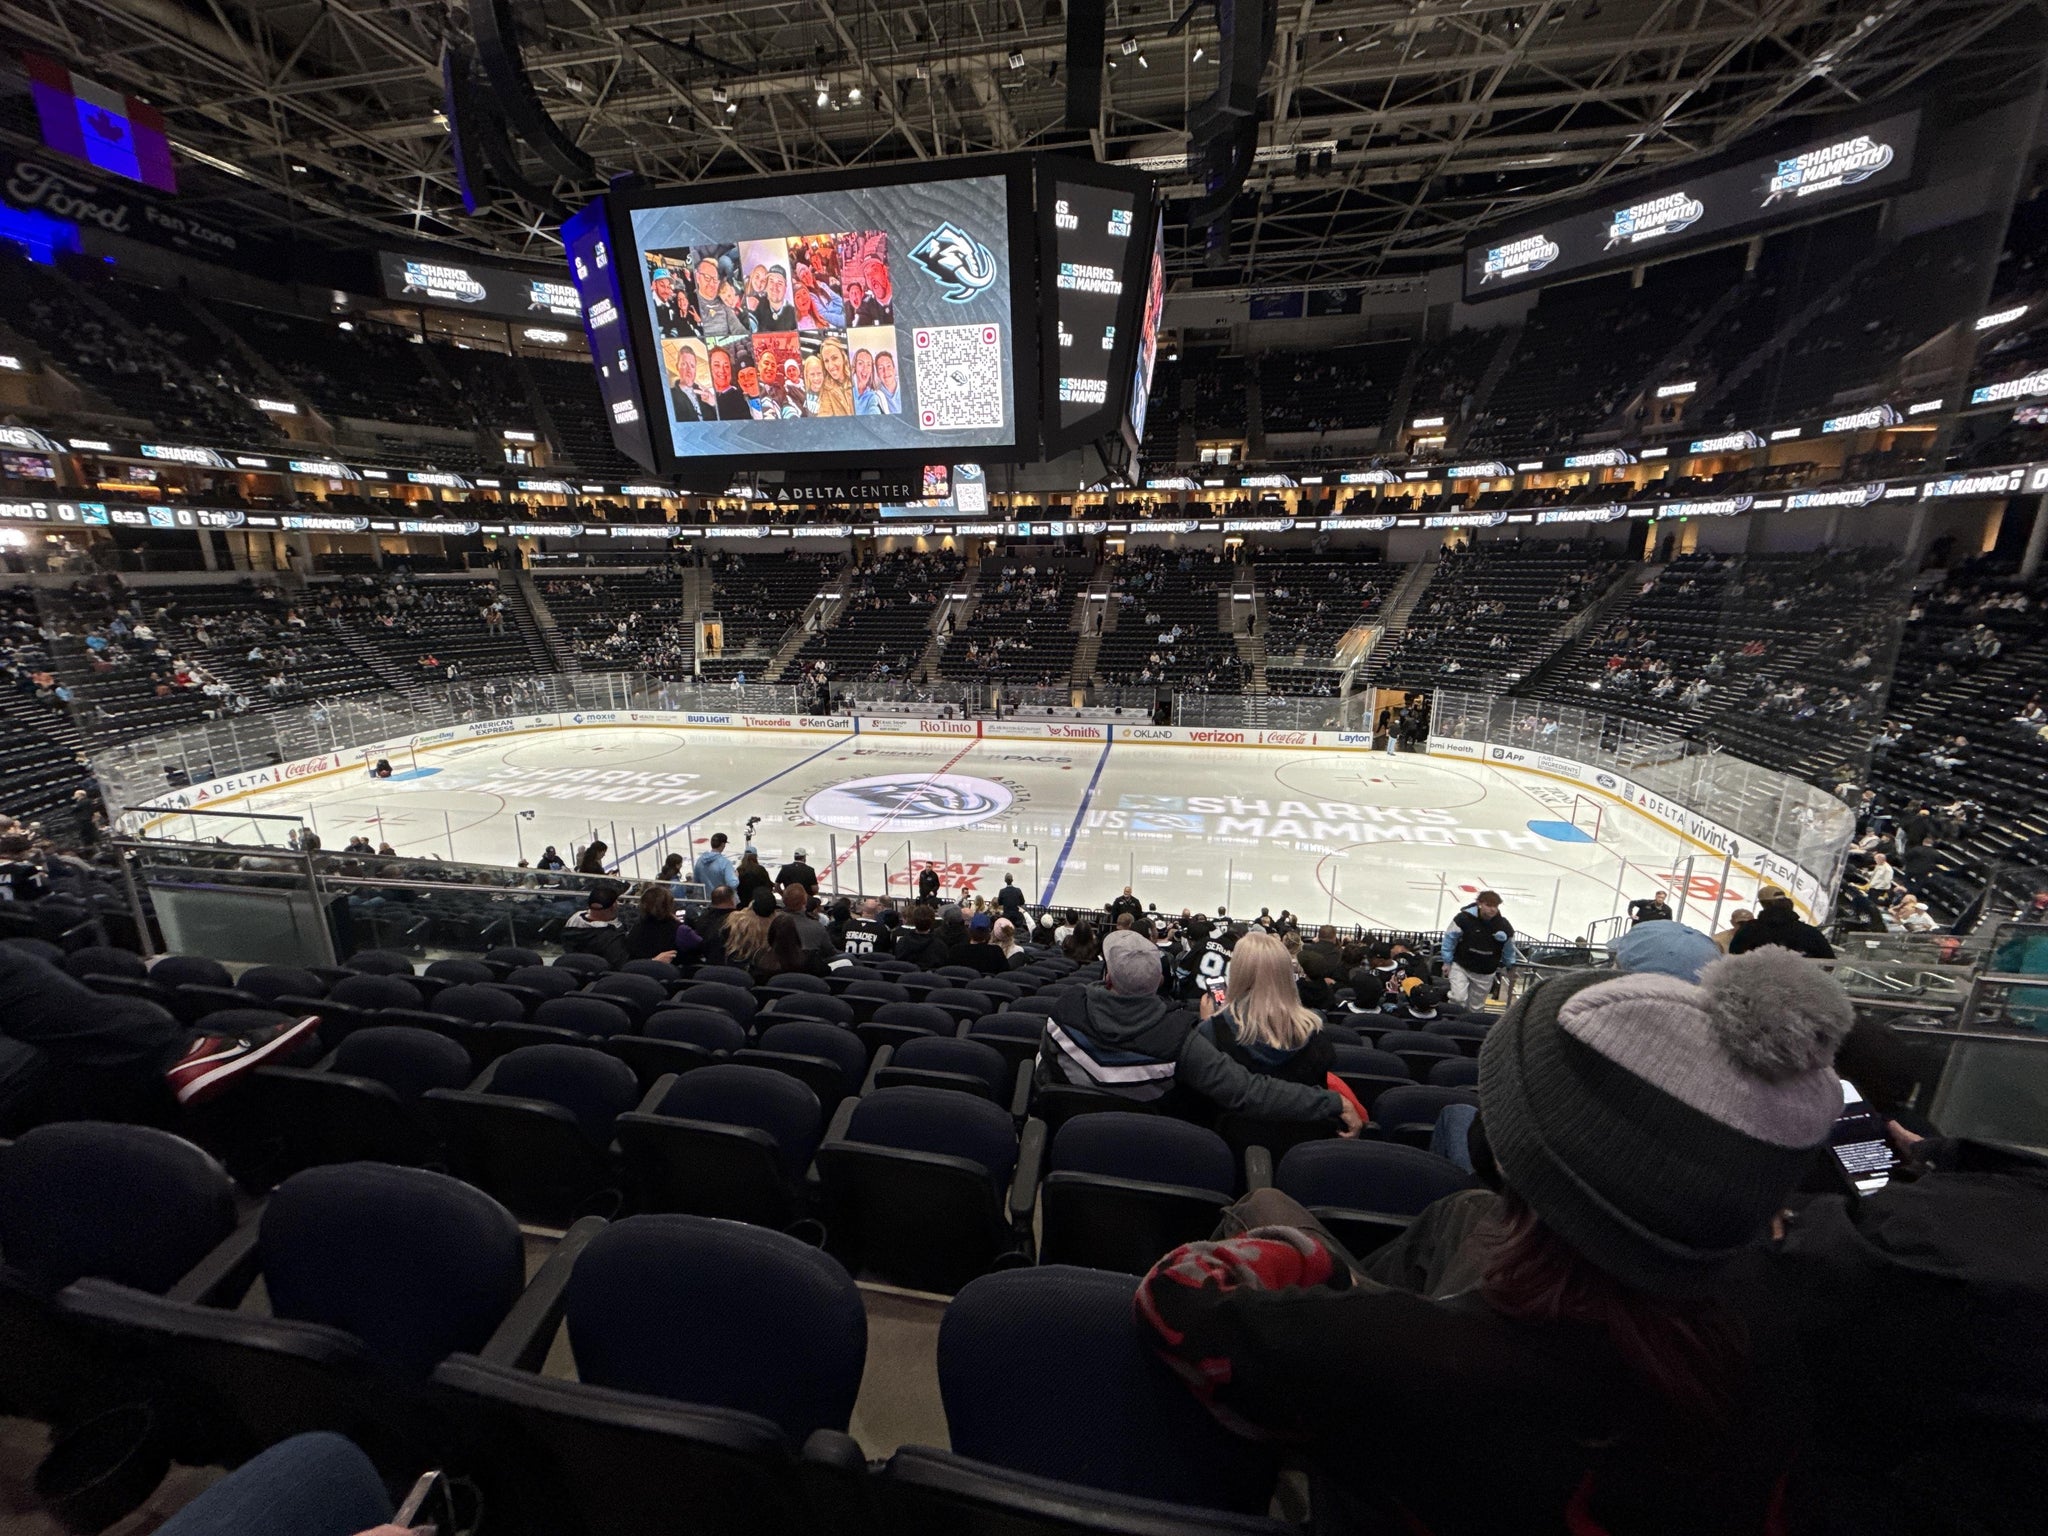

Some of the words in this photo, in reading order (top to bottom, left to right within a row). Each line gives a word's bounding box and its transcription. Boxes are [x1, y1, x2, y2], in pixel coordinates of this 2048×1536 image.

[1796, 135, 1869, 169] SHARKS
[1801, 144, 1885, 183] MAMMOTH
[6, 162, 129, 233] Ford
[145, 205, 186, 234] Fan
[190, 222, 236, 250] Zone
[1629, 192, 1685, 220] SHARKS
[1634, 201, 1697, 231] MAMMOTH
[1501, 234, 1544, 257] SHARKS
[1503, 242, 1554, 267] MAMMOTH
[420, 263, 467, 281] SHARKS
[1072, 264, 1114, 281] SHARKS
[427, 277, 480, 294] MAMMOTH
[543, 283, 580, 298] SHARK
[1076, 277, 1123, 295] MAMMOTH
[550, 295, 582, 308] MAMM
[1067, 378, 1108, 393] SHARKS
[1988, 372, 2048, 401] SHARKS
[1071, 390, 1106, 404] MAMMO
[1834, 410, 1882, 430] SHARKS
[1703, 434, 1744, 451] SHARKS
[156, 446, 208, 463] SHARKS
[1576, 453, 1615, 467] SHARKS
[300, 461, 340, 475] SHARKS
[1458, 465, 1494, 477] SHARKS
[418, 473, 453, 485] SHARKS
[1155, 478, 1185, 489] SHARKS
[1250, 477, 1281, 487] SHARKS
[1349, 472, 1384, 483] SHARKS
[528, 480, 562, 492] SHARKS
[630, 486, 661, 496] SHARKS
[793, 487, 844, 499] DELTA
[850, 485, 910, 497] CENTER
[1950, 475, 2009, 495] MAMMO
[1807, 490, 1867, 507] MAMMOTH
[57, 504, 75, 521] 0
[111, 511, 146, 523] 8:53
[177, 510, 192, 525] 0
[1558, 508, 1610, 522] MAMMOTH
[1680, 502, 1734, 515] MAMMOTH
[302, 518, 355, 530] MAMMOTH
[418, 522, 466, 534] MAMMOTH
[1150, 522, 1187, 532] MAMMOTH
[1240, 520, 1281, 531] MAMMOTH
[1337, 519, 1383, 530] MAMMOTH
[1442, 516, 1492, 527] MAMMOTH
[527, 526, 571, 536] MAMMOTH
[627, 527, 669, 537] MAMMOTH
[721, 527, 759, 537] MAMMOTH
[804, 527, 842, 537] MAMMOTH
[970, 526, 998, 536] MAMMO
[469, 719, 513, 731] AMERICAN
[688, 715, 705, 723] BUD
[706, 716, 730, 724] LIGHT
[750, 717, 792, 727] Trucordia
[808, 718, 826, 727] Ken
[827, 719, 849, 728] Garff
[920, 720, 940, 732] Rio
[940, 721, 972, 733] Tinto
[476, 725, 515, 736] EXPRESS
[1063, 725, 1101, 738] Smith's
[1133, 730, 1173, 740] OKLAND
[1189, 730, 1244, 743] verizon
[1338, 733, 1370, 744] Layton
[1430, 742, 1445, 750] omi
[1446, 744, 1474, 754] Health
[1004, 755, 1072, 763] PACS
[1541, 761, 1580, 775] INGREDIENTS
[488, 766, 701, 787] SHARKS
[213, 773, 270, 795] DELTA
[1186, 796, 1460, 826] SHARKS
[1649, 798, 1684, 825] DELTA
[1087, 810, 1128, 829] VS
[1216, 815, 1551, 853] MAMMOTH
[1691, 819, 1728, 852] vivint
[906, 859, 989, 876] SEAT
[1765, 859, 1804, 891] FILEVE
[845, 930, 878, 943] SERGACHEV
[1206, 941, 1233, 958] SERGA
